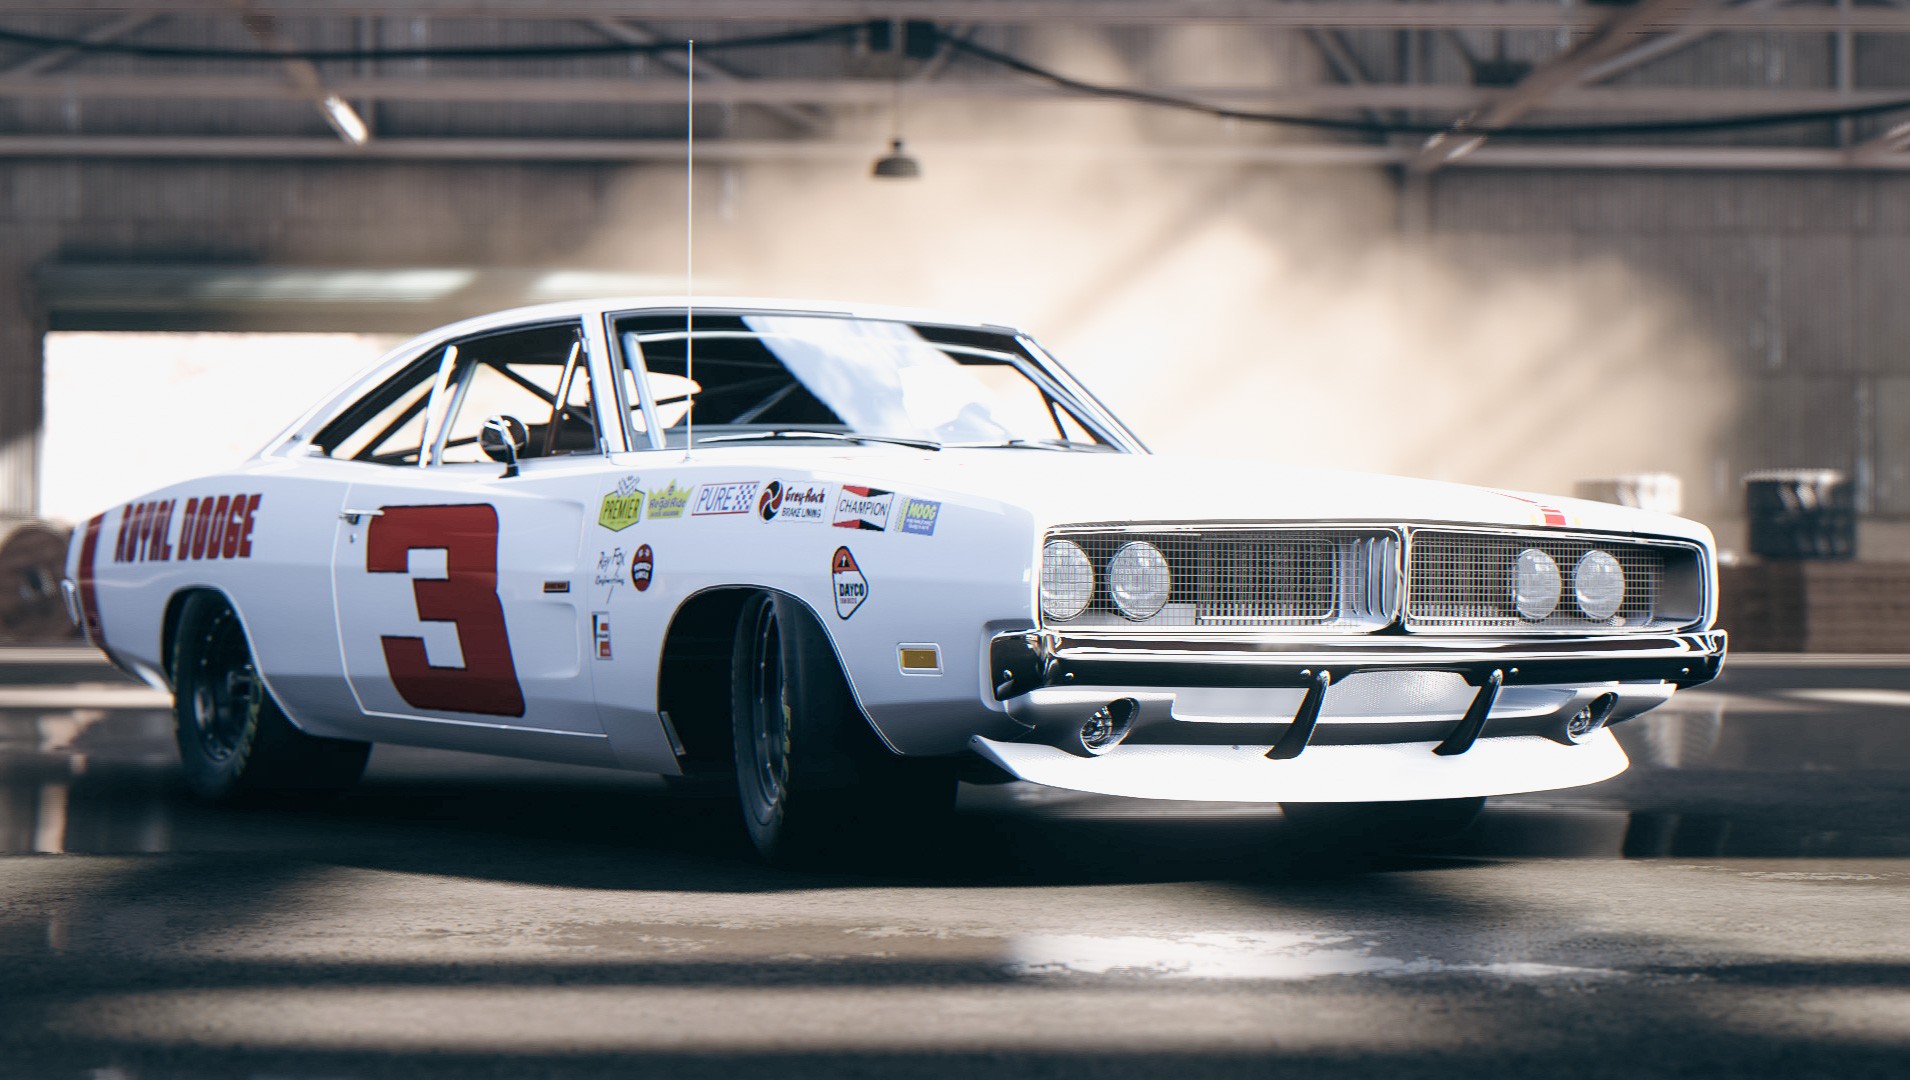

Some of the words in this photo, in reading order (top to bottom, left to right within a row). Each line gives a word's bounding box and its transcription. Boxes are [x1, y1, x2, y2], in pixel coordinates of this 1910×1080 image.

[700, 486, 736, 512] PURE
[839, 499, 888, 516] CHAMPION
[602, 499, 640, 520] PREMIER
[781, 507, 801, 517] BRAKE
[801, 508, 822, 518] LINING
[907, 502, 938, 520] MOOG
[114, 498, 176, 563] ROYAL
[177, 493, 263, 561] DODGE
[838, 583, 865, 597] DAYCO
[367, 503, 526, 717] 3
